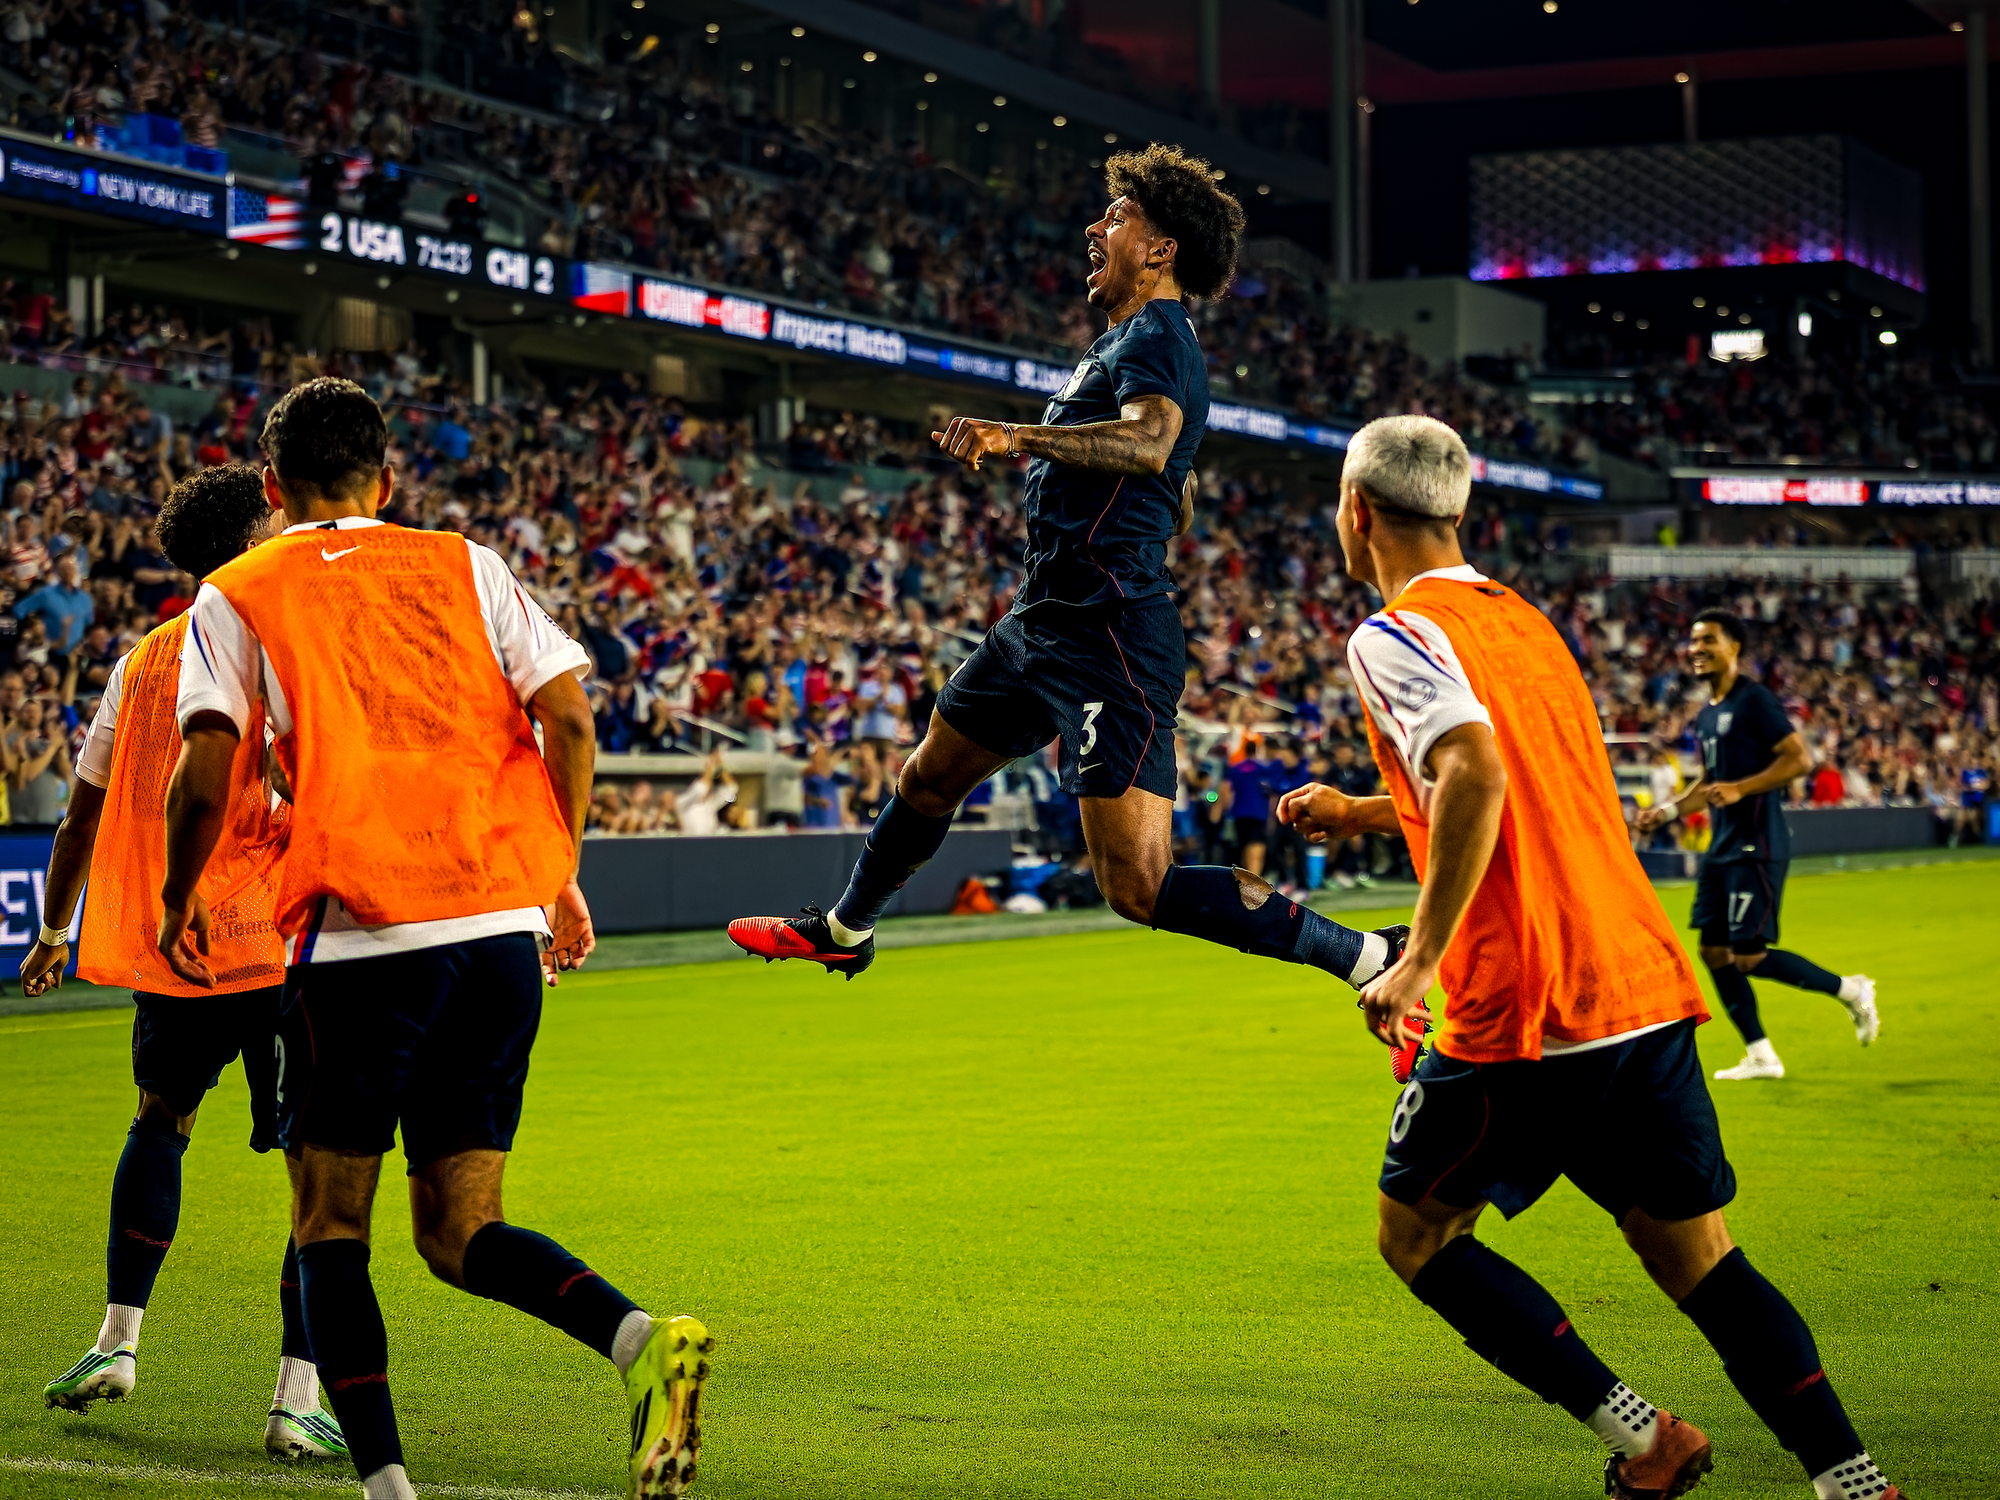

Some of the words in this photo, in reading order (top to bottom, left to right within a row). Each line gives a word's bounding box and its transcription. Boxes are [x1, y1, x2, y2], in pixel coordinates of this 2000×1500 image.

[99, 172, 136, 202] NEW
[137, 180, 181, 212] YORK
[181, 186, 214, 218] LIFE
[320, 212, 343, 252] 2
[347, 216, 407, 265] USA
[486, 247, 531, 290] CHI
[534, 256, 555, 295] 2
[1079, 701, 1104, 756] 3
[1728, 892, 1753, 923] 17
[274, 1034, 286, 1103] 2
[1389, 1079, 1425, 1144] 8
